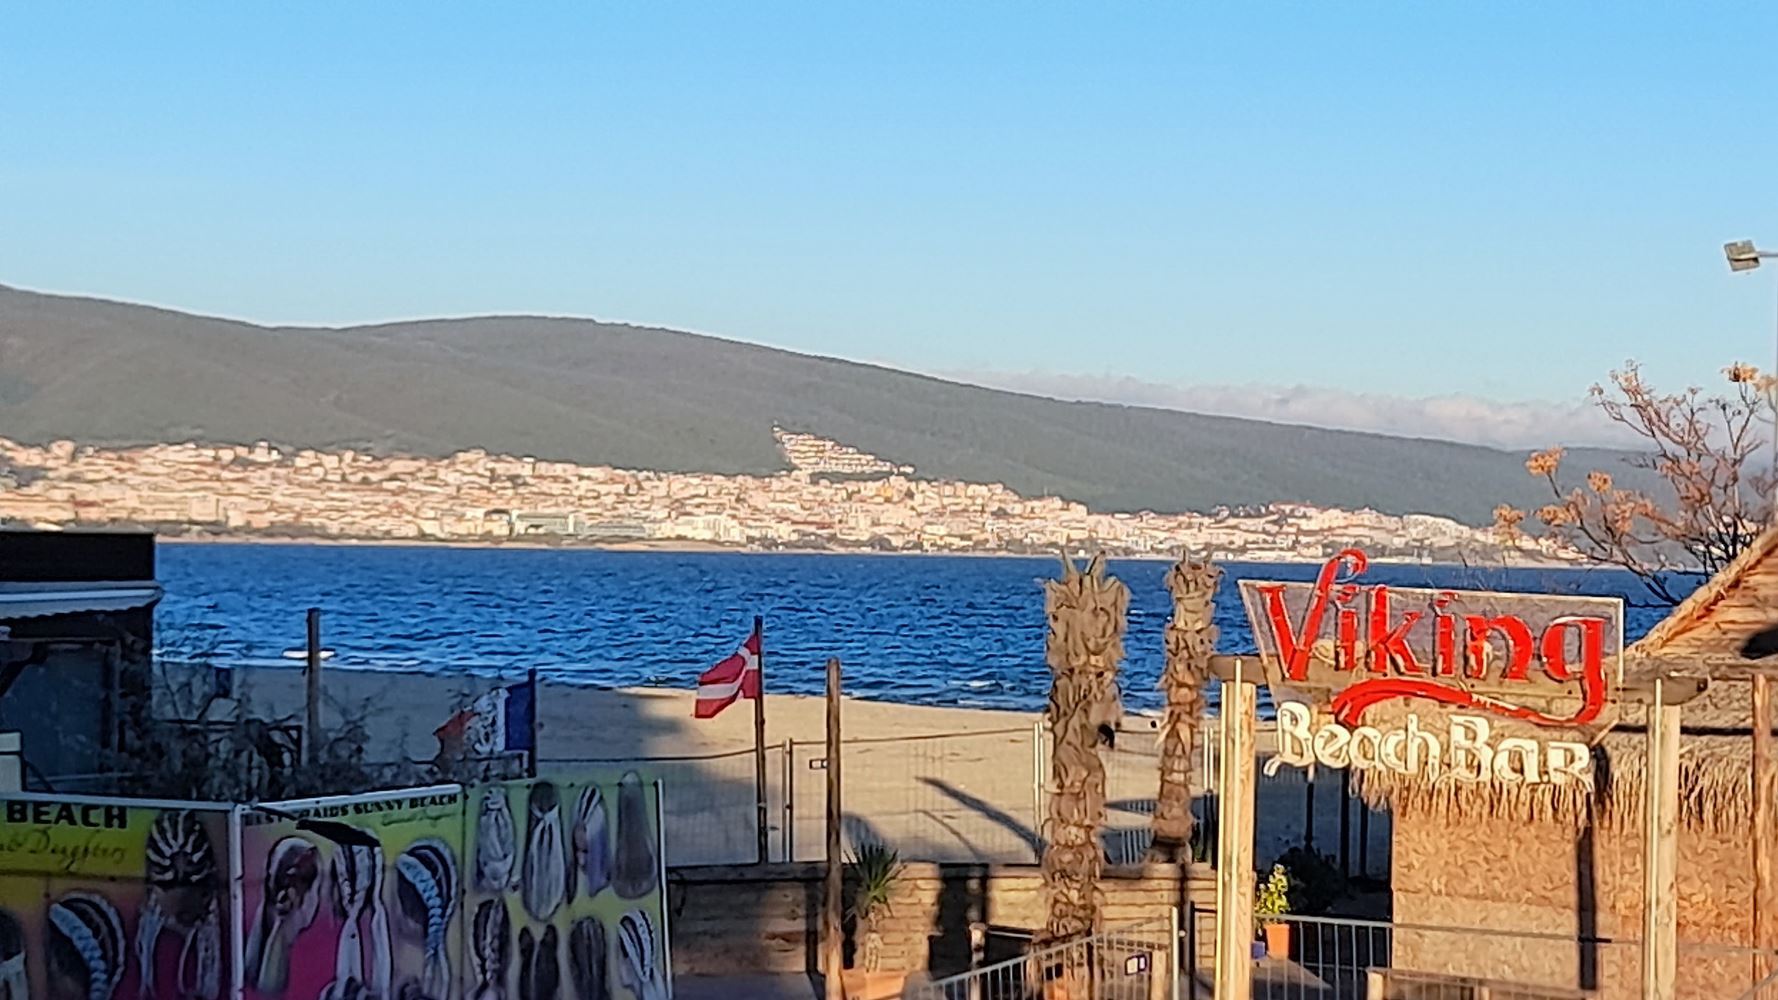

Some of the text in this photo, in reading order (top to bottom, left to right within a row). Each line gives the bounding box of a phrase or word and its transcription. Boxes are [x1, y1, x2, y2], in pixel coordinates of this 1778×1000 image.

[1256, 548, 1608, 727] Viking
[1263, 701, 1441, 782] Beach
[7, 800, 127, 829] BEACH
